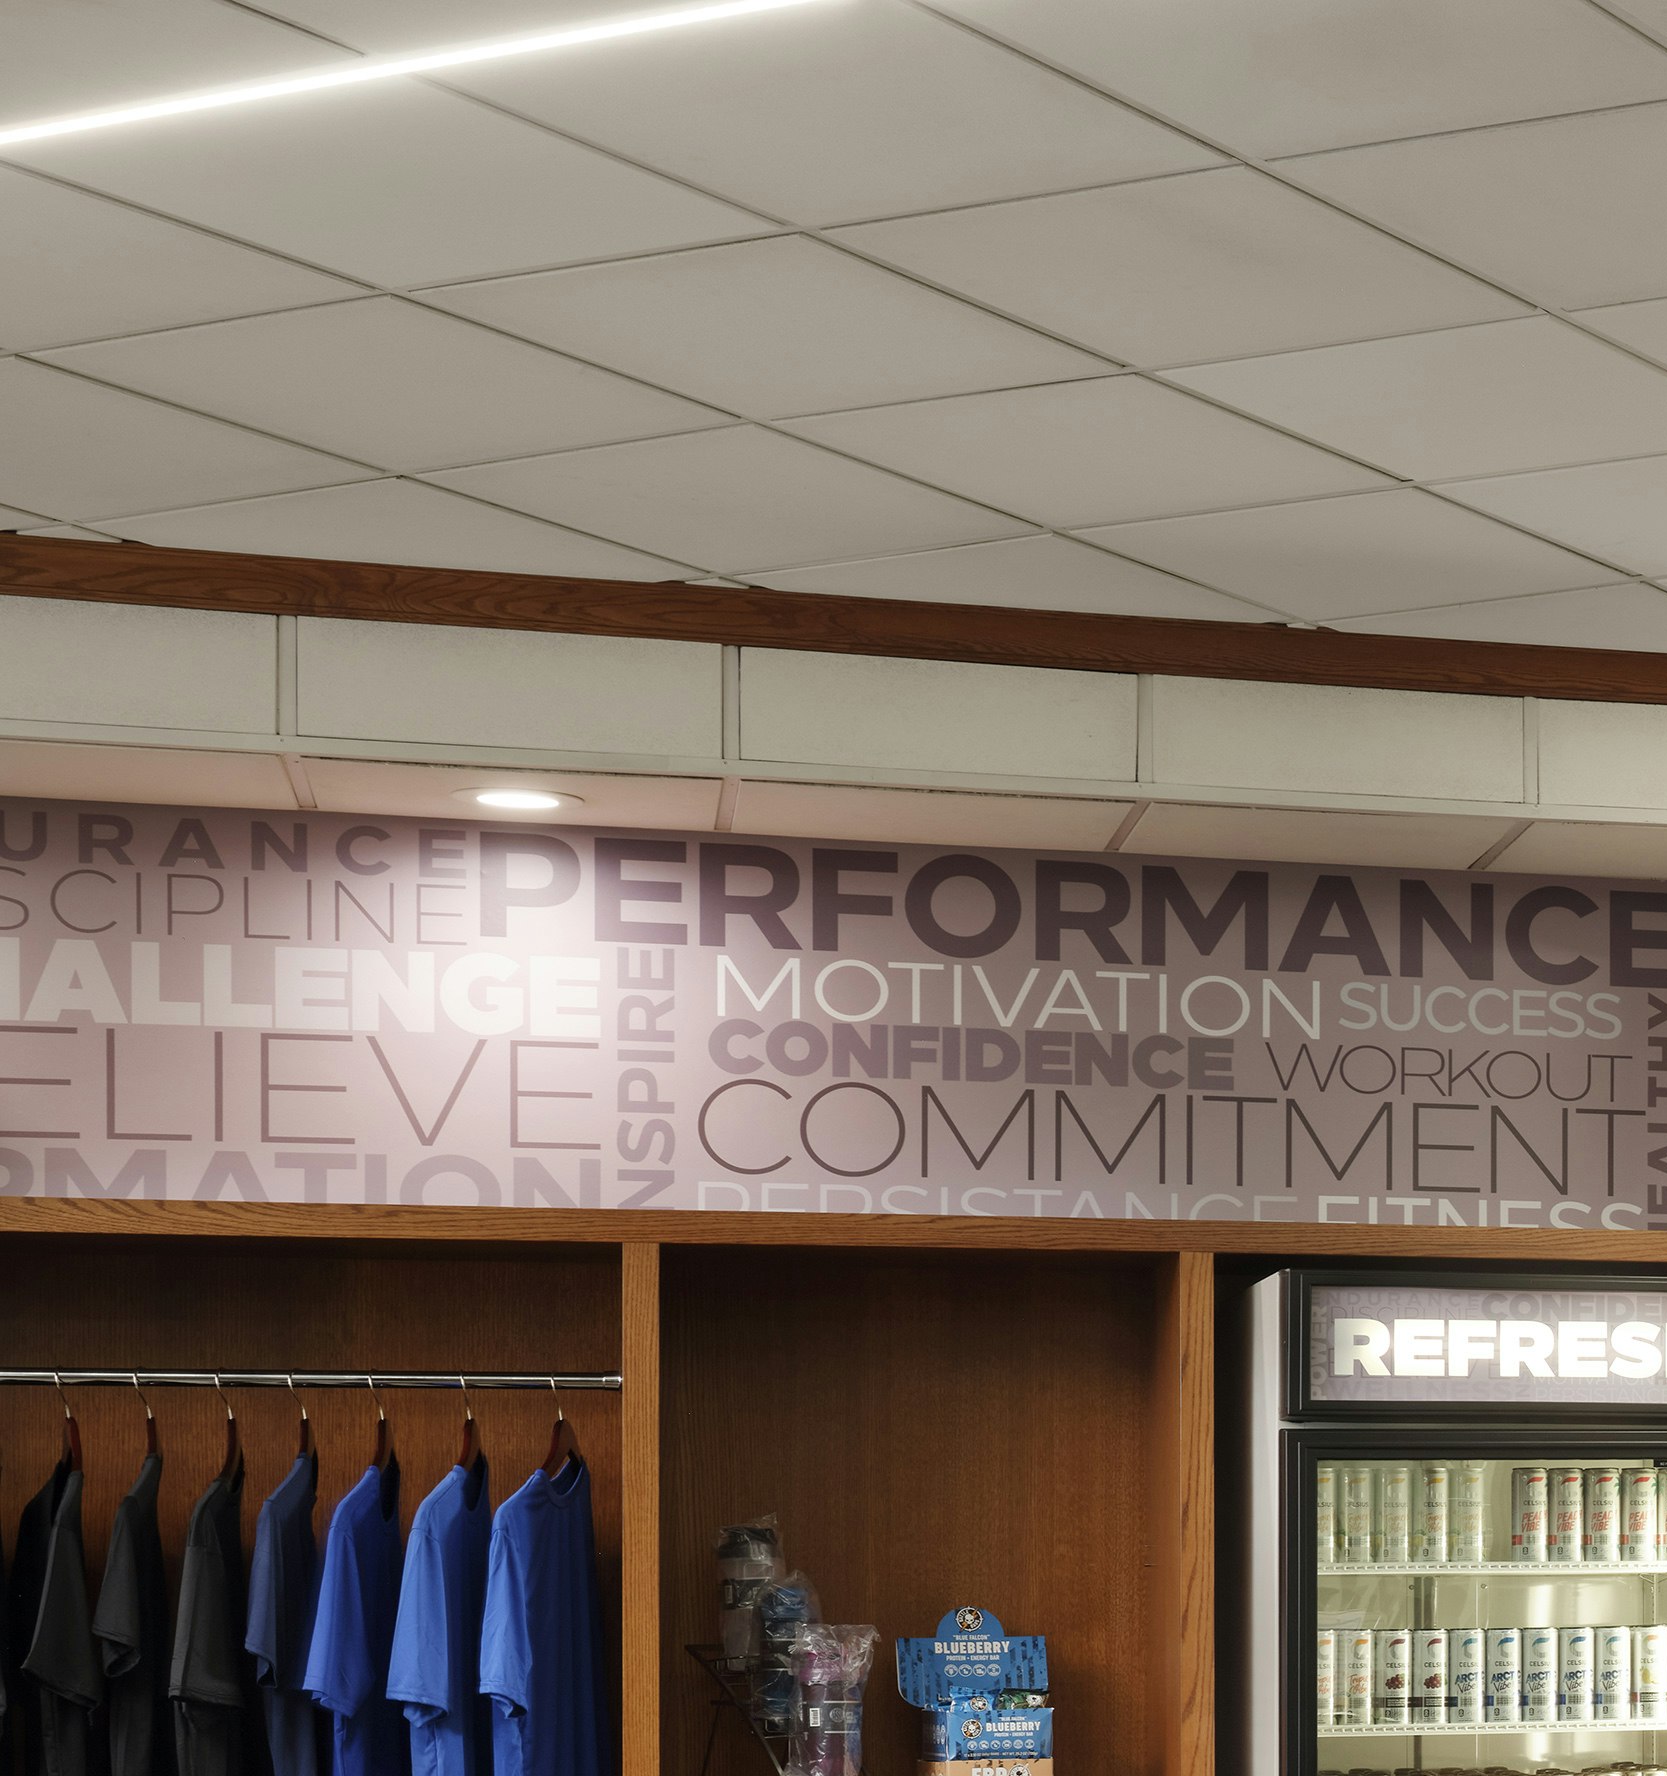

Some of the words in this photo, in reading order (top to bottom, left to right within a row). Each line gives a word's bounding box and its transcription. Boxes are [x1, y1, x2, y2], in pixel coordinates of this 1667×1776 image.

[716, 954, 1320, 1040] MOTIVATION
[1338, 982, 1623, 1041] SUCCESS
[708, 1018, 1235, 1092] CONFIDENCE
[1265, 1042, 1633, 1104] WORKOUT
[698, 1078, 1647, 1197] COMMITMENT
[934, 1641, 1010, 1654] BLUEBERRY
[986, 1721, 1041, 1732] BLUEBERRY
